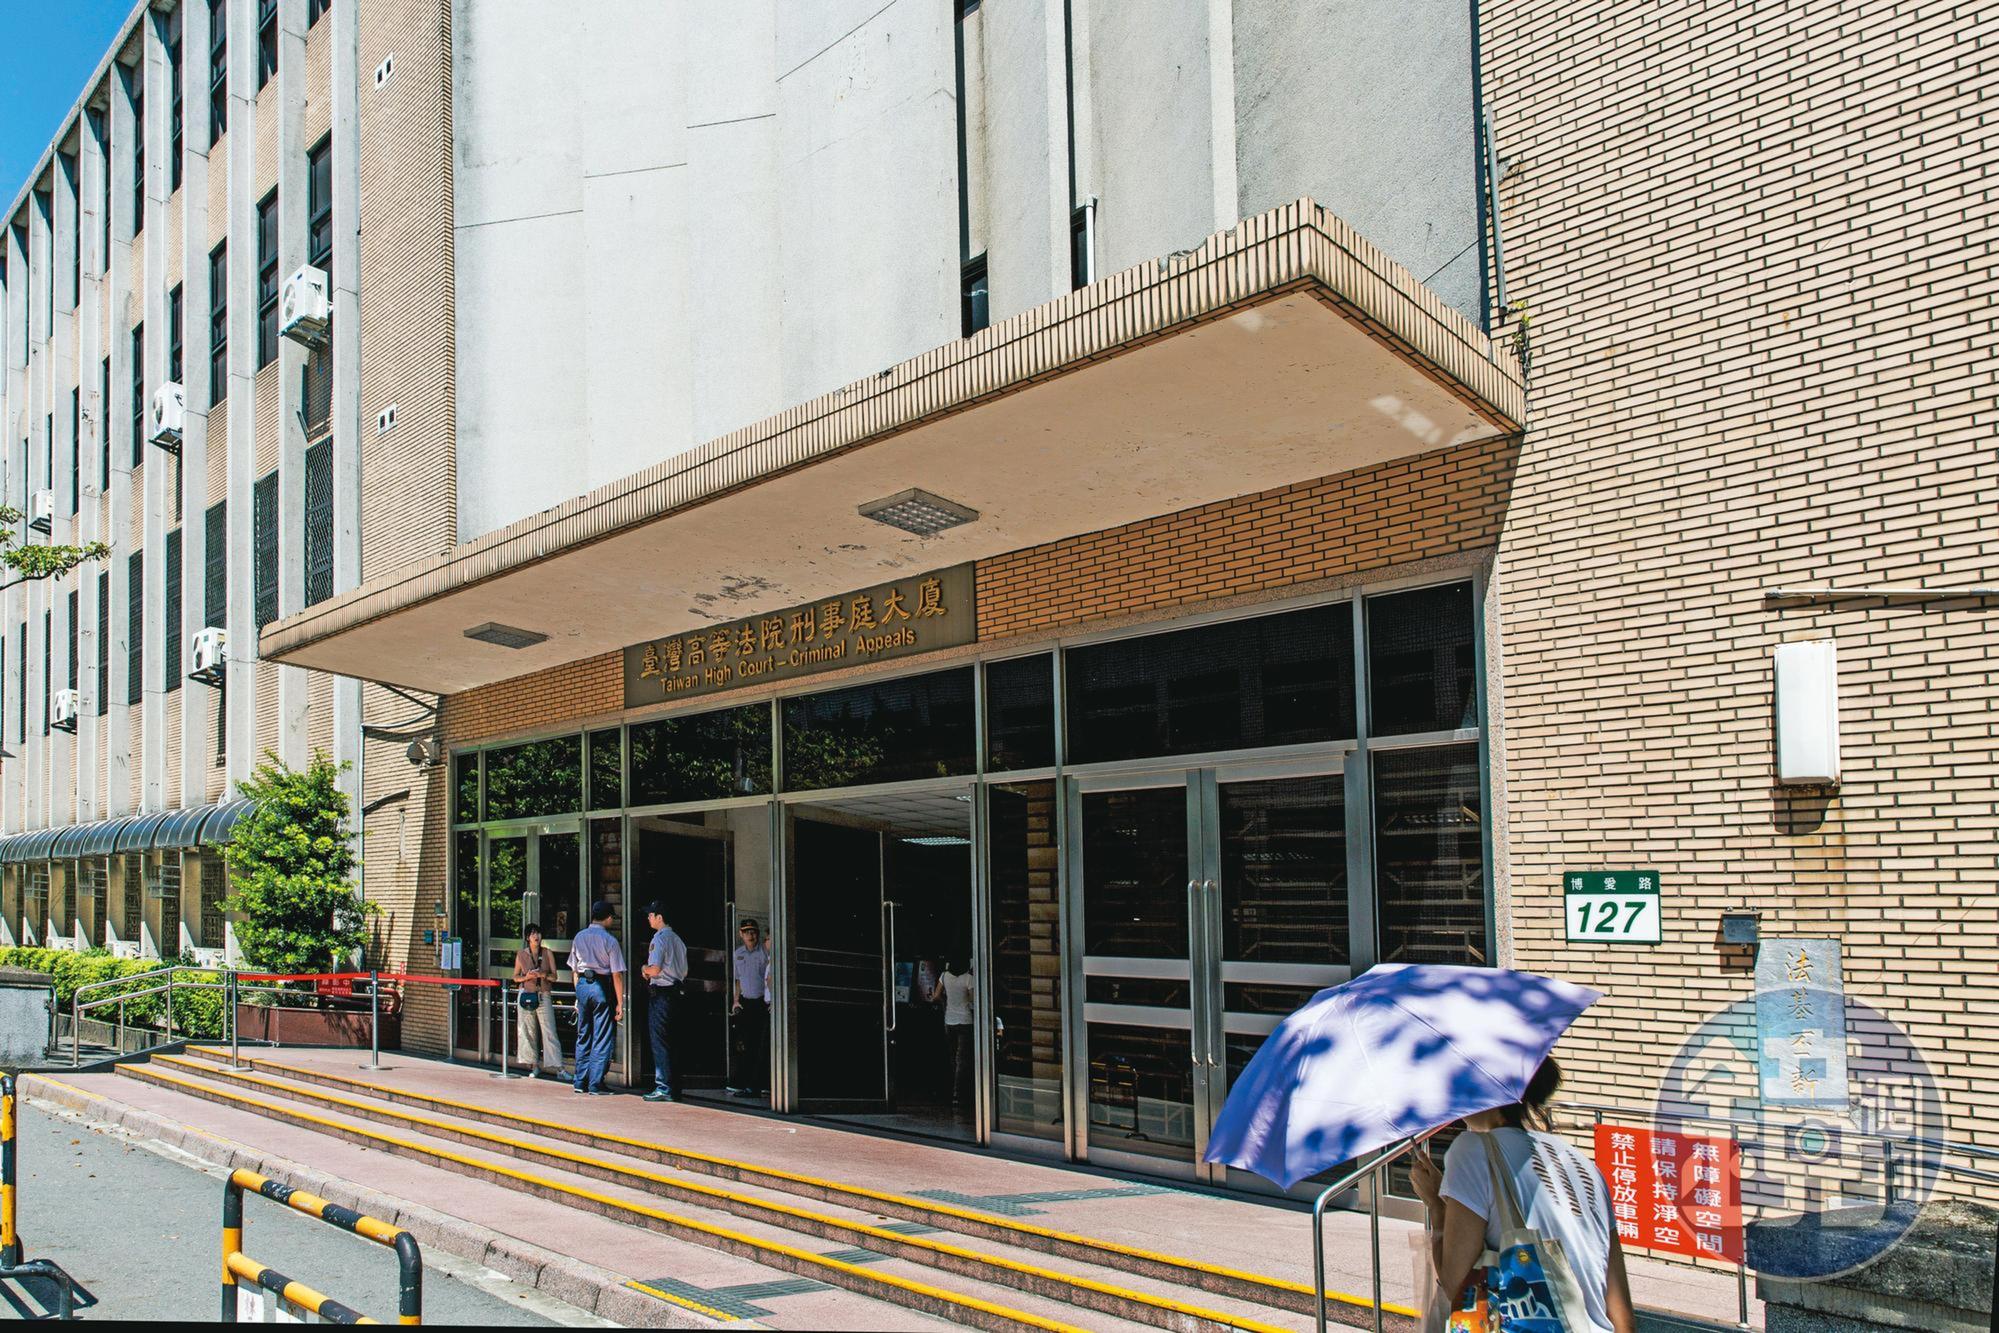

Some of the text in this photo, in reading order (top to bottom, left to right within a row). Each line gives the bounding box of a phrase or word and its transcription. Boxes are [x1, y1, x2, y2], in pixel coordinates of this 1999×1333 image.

[640, 576, 949, 679] 臺灣高等法院刑事庭大廈
[660, 676, 699, 694] Taiwan
[704, 666, 732, 687] High
[738, 657, 774, 677] Court
[790, 640, 846, 667] Criminal
[855, 626, 916, 657] Appeals
[1570, 877, 1652, 891] 博愛路
[1577, 901, 1647, 933] 127
[1610, 1131, 1640, 1240] 禁止停放車輛
[1650, 1136, 1681, 1247] 請保持淨空
[1692, 1141, 1723, 1254] 無障礙空間
